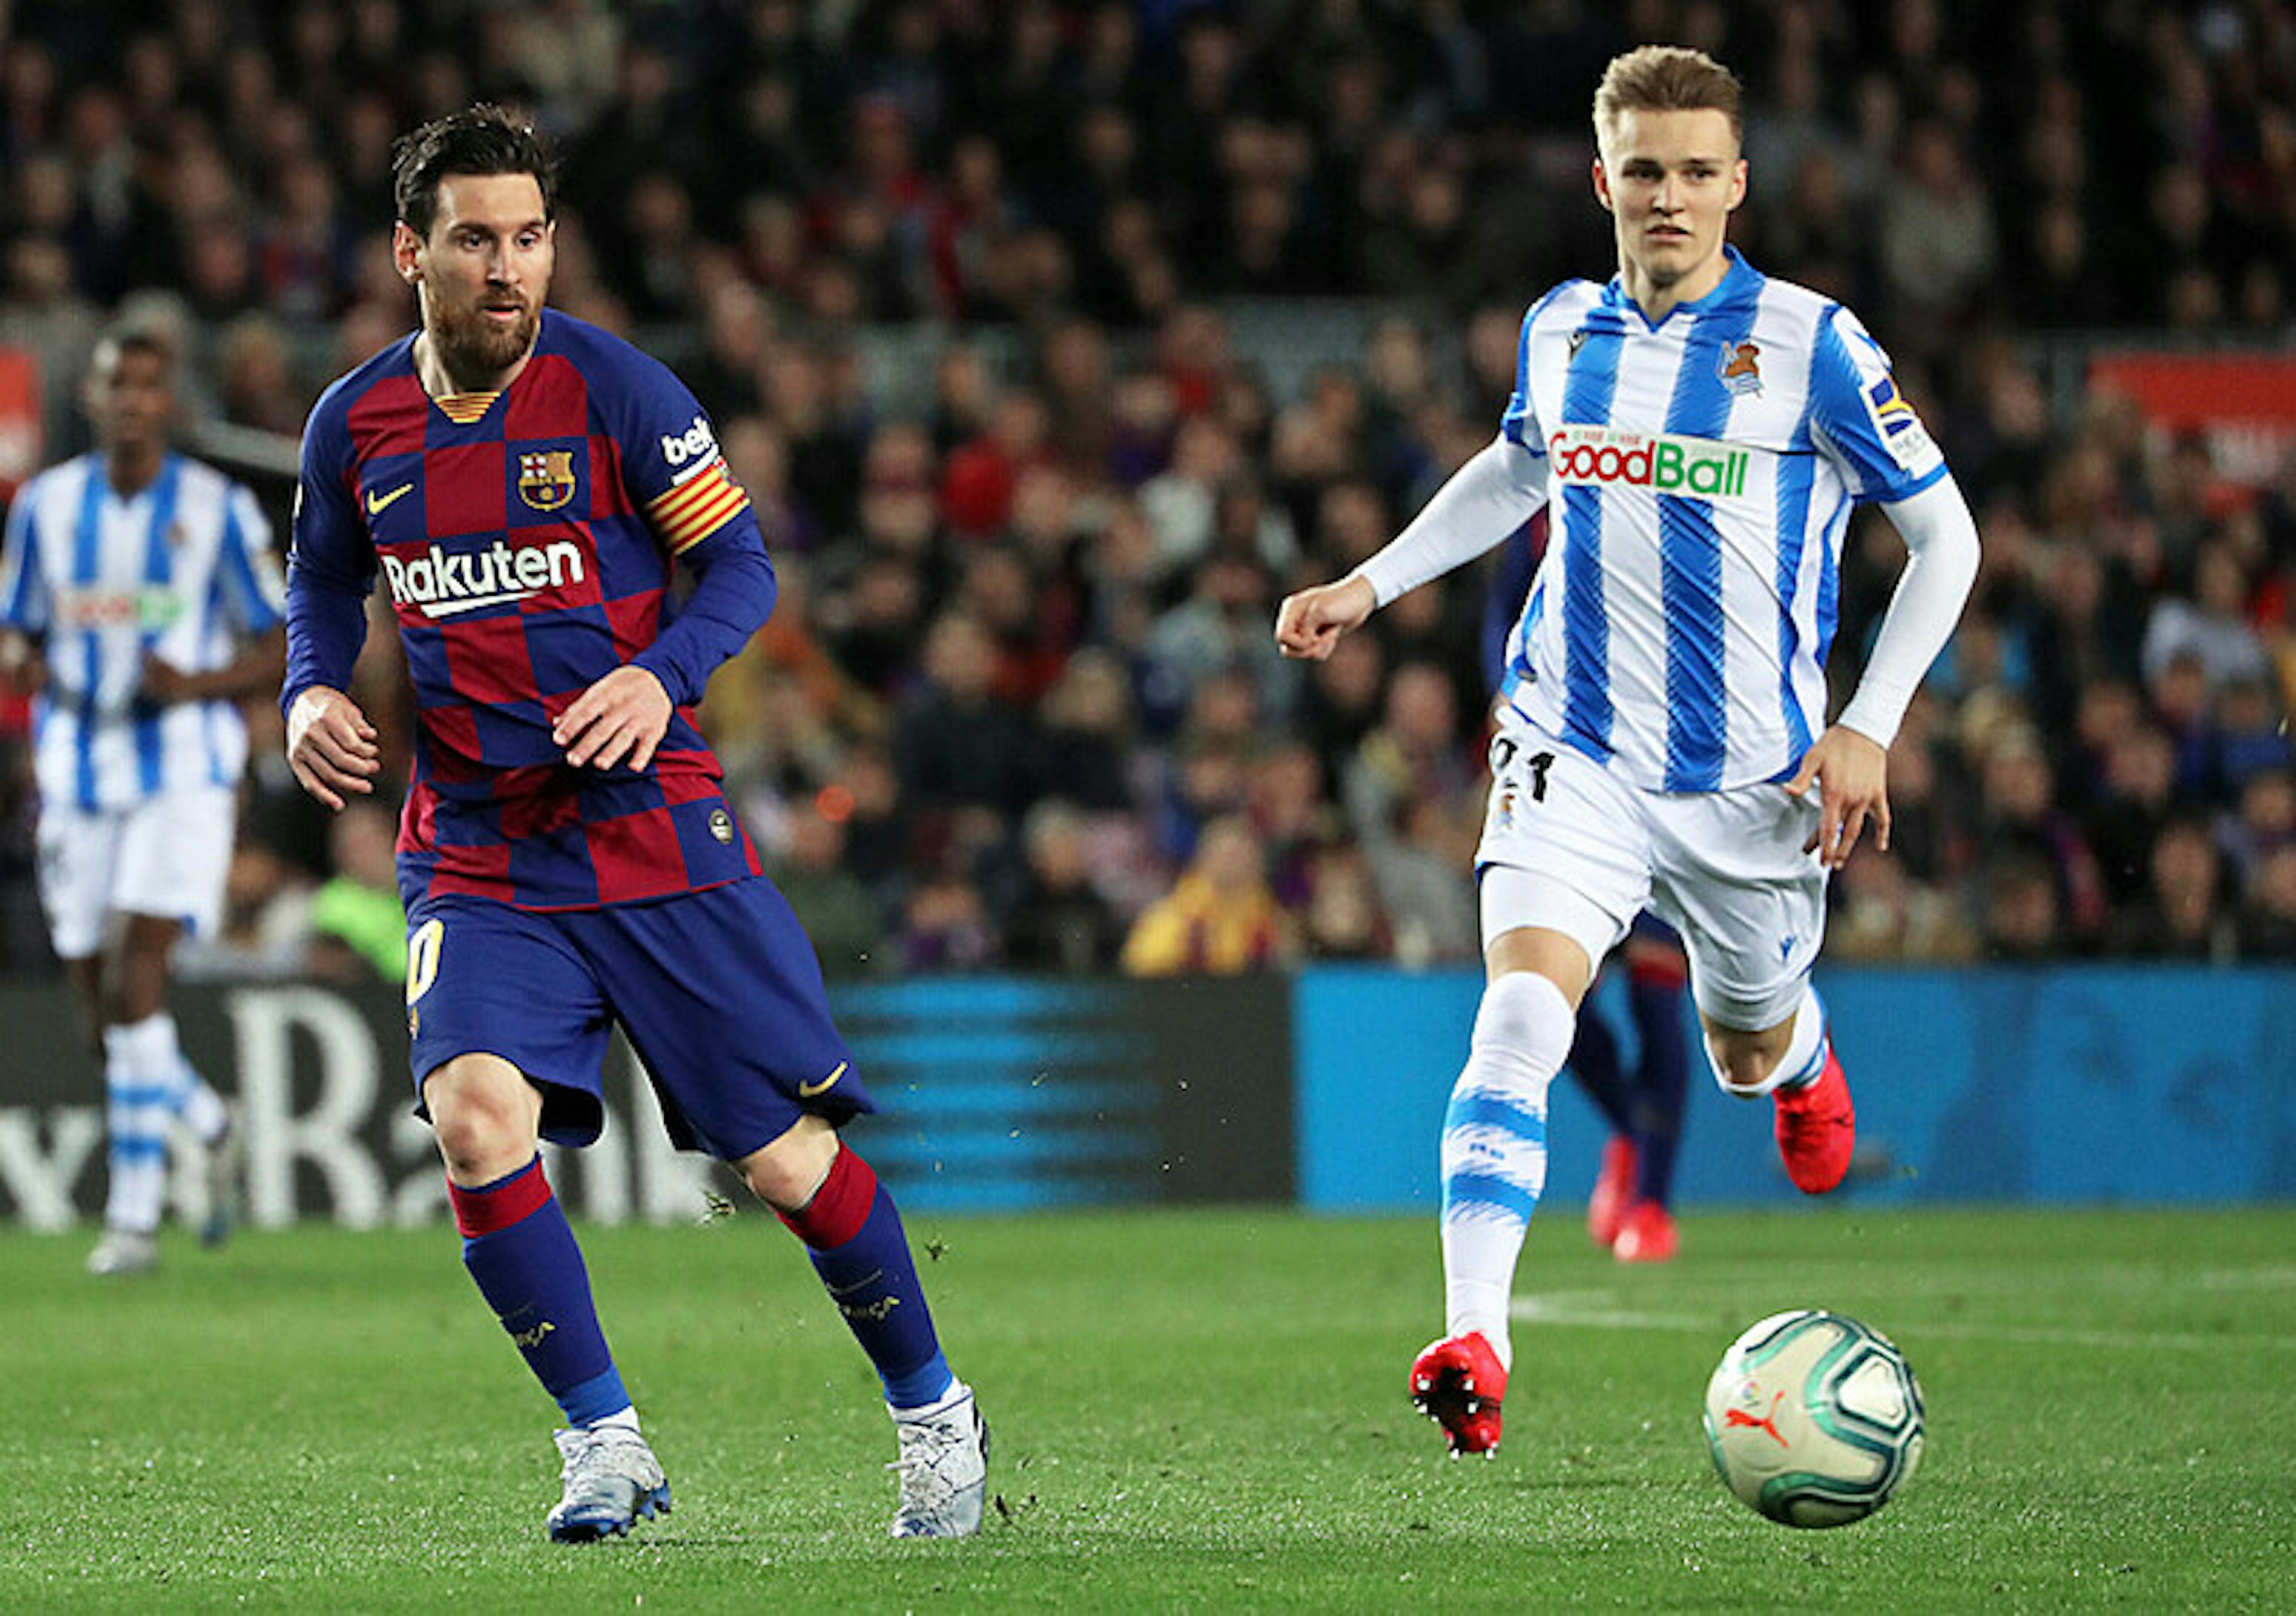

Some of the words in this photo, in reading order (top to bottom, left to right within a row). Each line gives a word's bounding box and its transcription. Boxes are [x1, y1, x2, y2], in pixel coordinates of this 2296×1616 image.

[661, 414, 715, 462] bek
[1550, 431, 1749, 496] GoodBall
[381, 541, 584, 604] Rakuten
